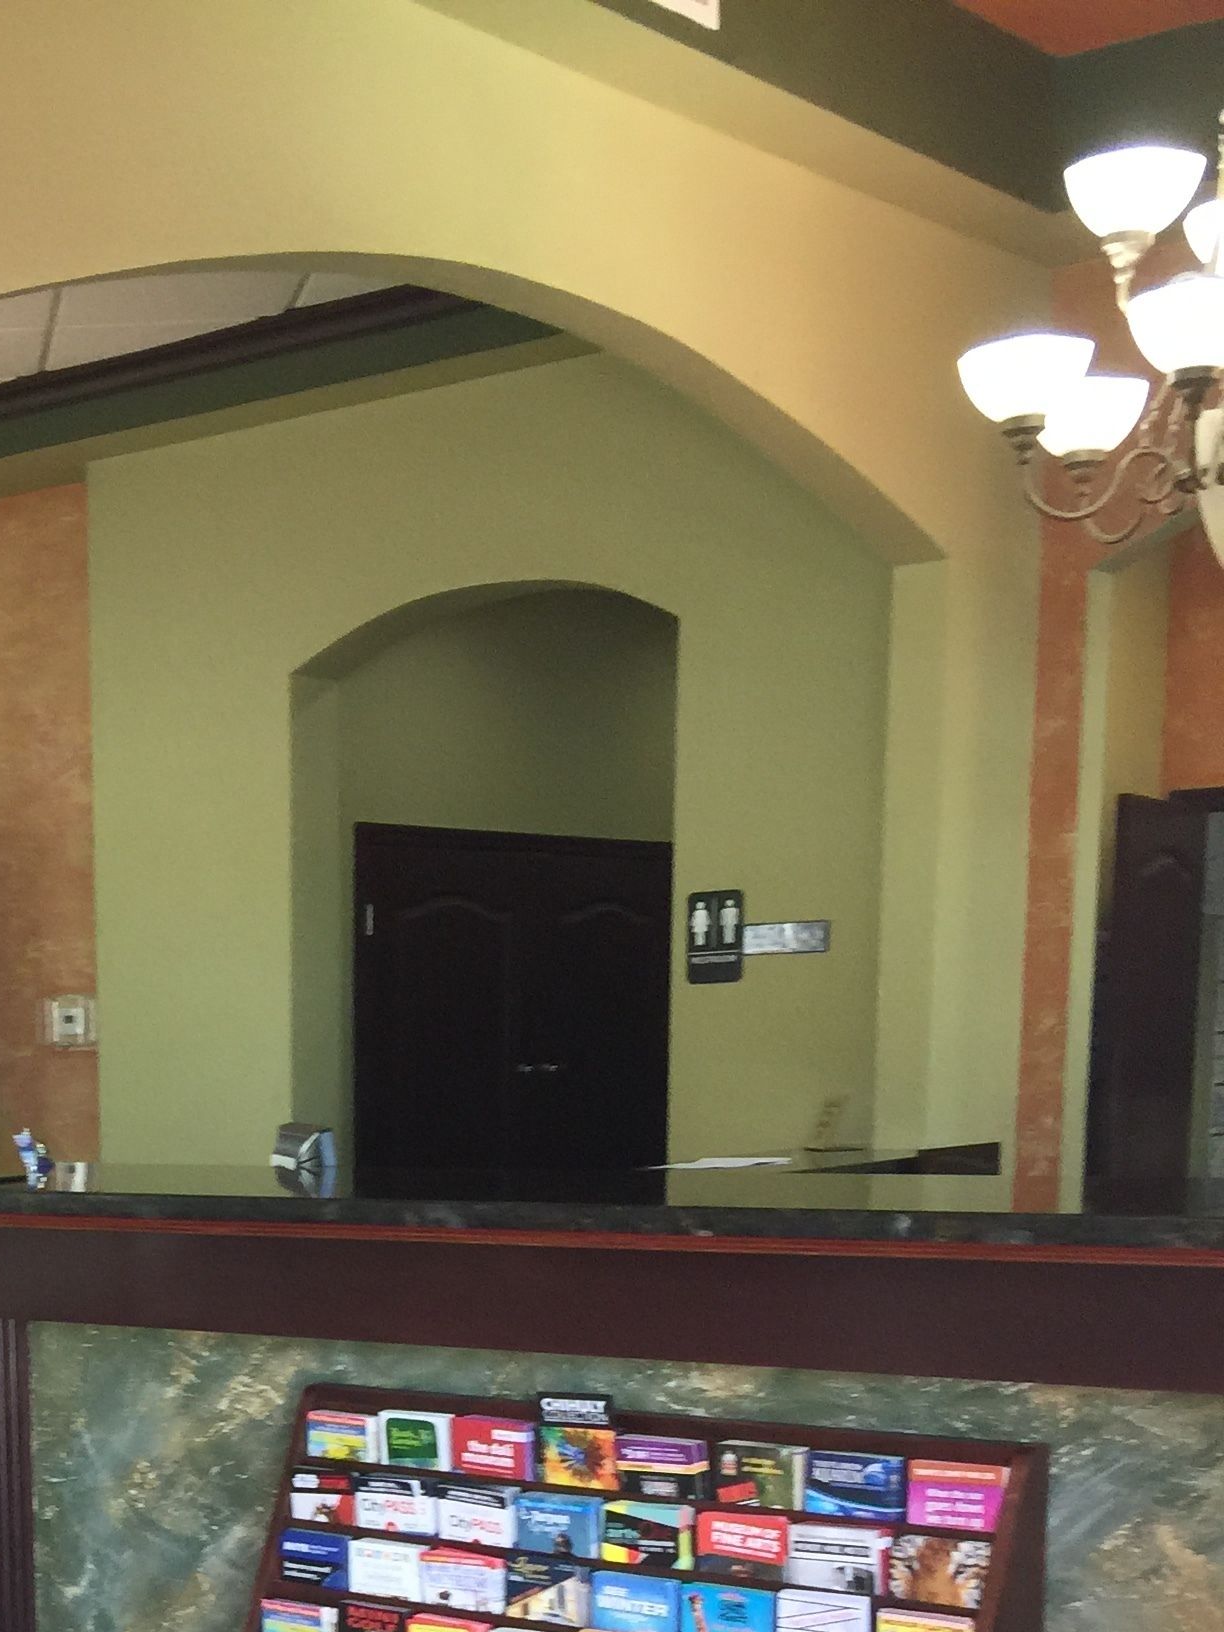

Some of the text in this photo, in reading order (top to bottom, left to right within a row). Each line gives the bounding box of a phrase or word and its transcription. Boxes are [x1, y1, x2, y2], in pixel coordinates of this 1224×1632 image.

[710, 1531, 745, 1547] FINE
[745, 1535, 783, 1553] ARTS
[762, 1527, 783, 1540] OF
[596, 1594, 670, 1617] WINTER
